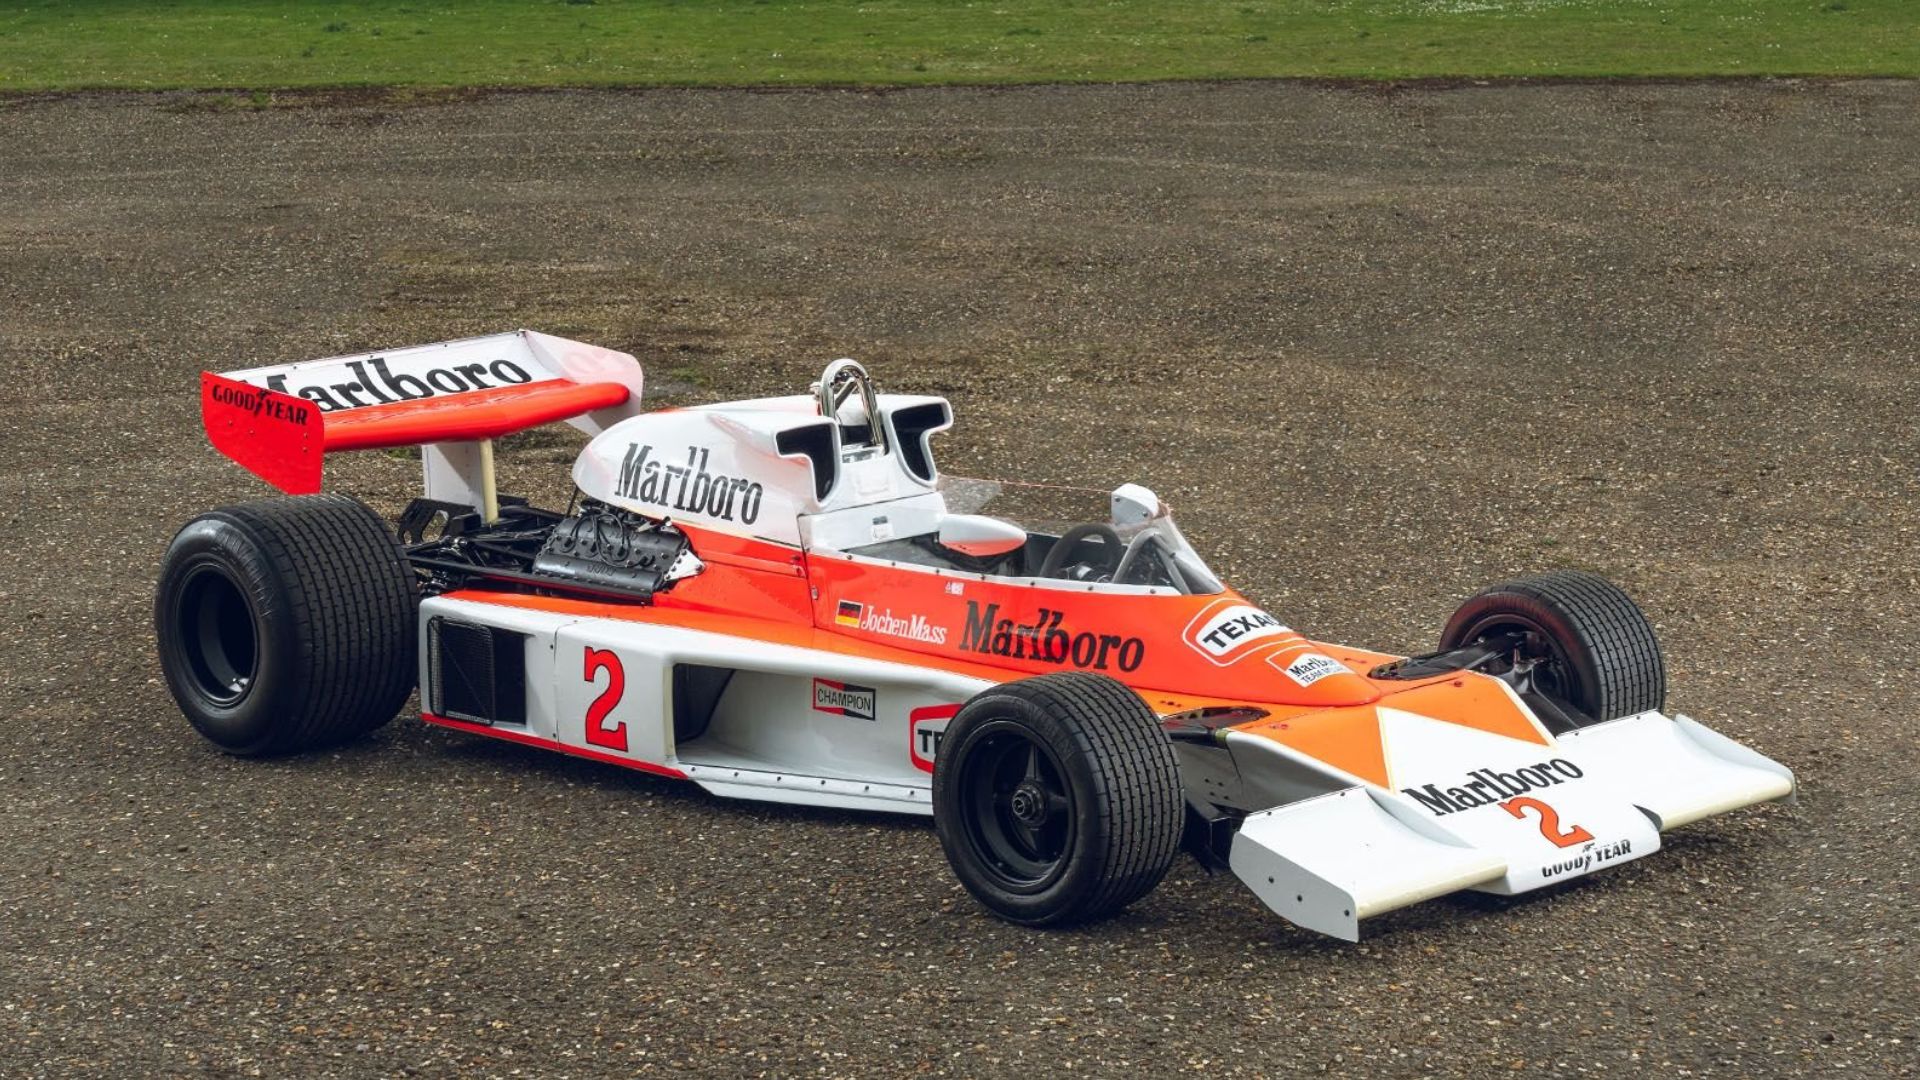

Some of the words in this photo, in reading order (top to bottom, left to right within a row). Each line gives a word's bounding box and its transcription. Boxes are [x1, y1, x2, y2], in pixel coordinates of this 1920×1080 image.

[614, 442, 763, 525] Marlboro
[861, 605, 909, 638] Jochen
[908, 614, 948, 645] Mass
[959, 600, 1145, 673] Marlboro
[1203, 614, 1279, 648] TEXA
[583, 645, 629, 753] 2
[816, 688, 871, 712] CHAMPION
[1400, 758, 1584, 817] Marlboro
[1497, 796, 1595, 849] 2
